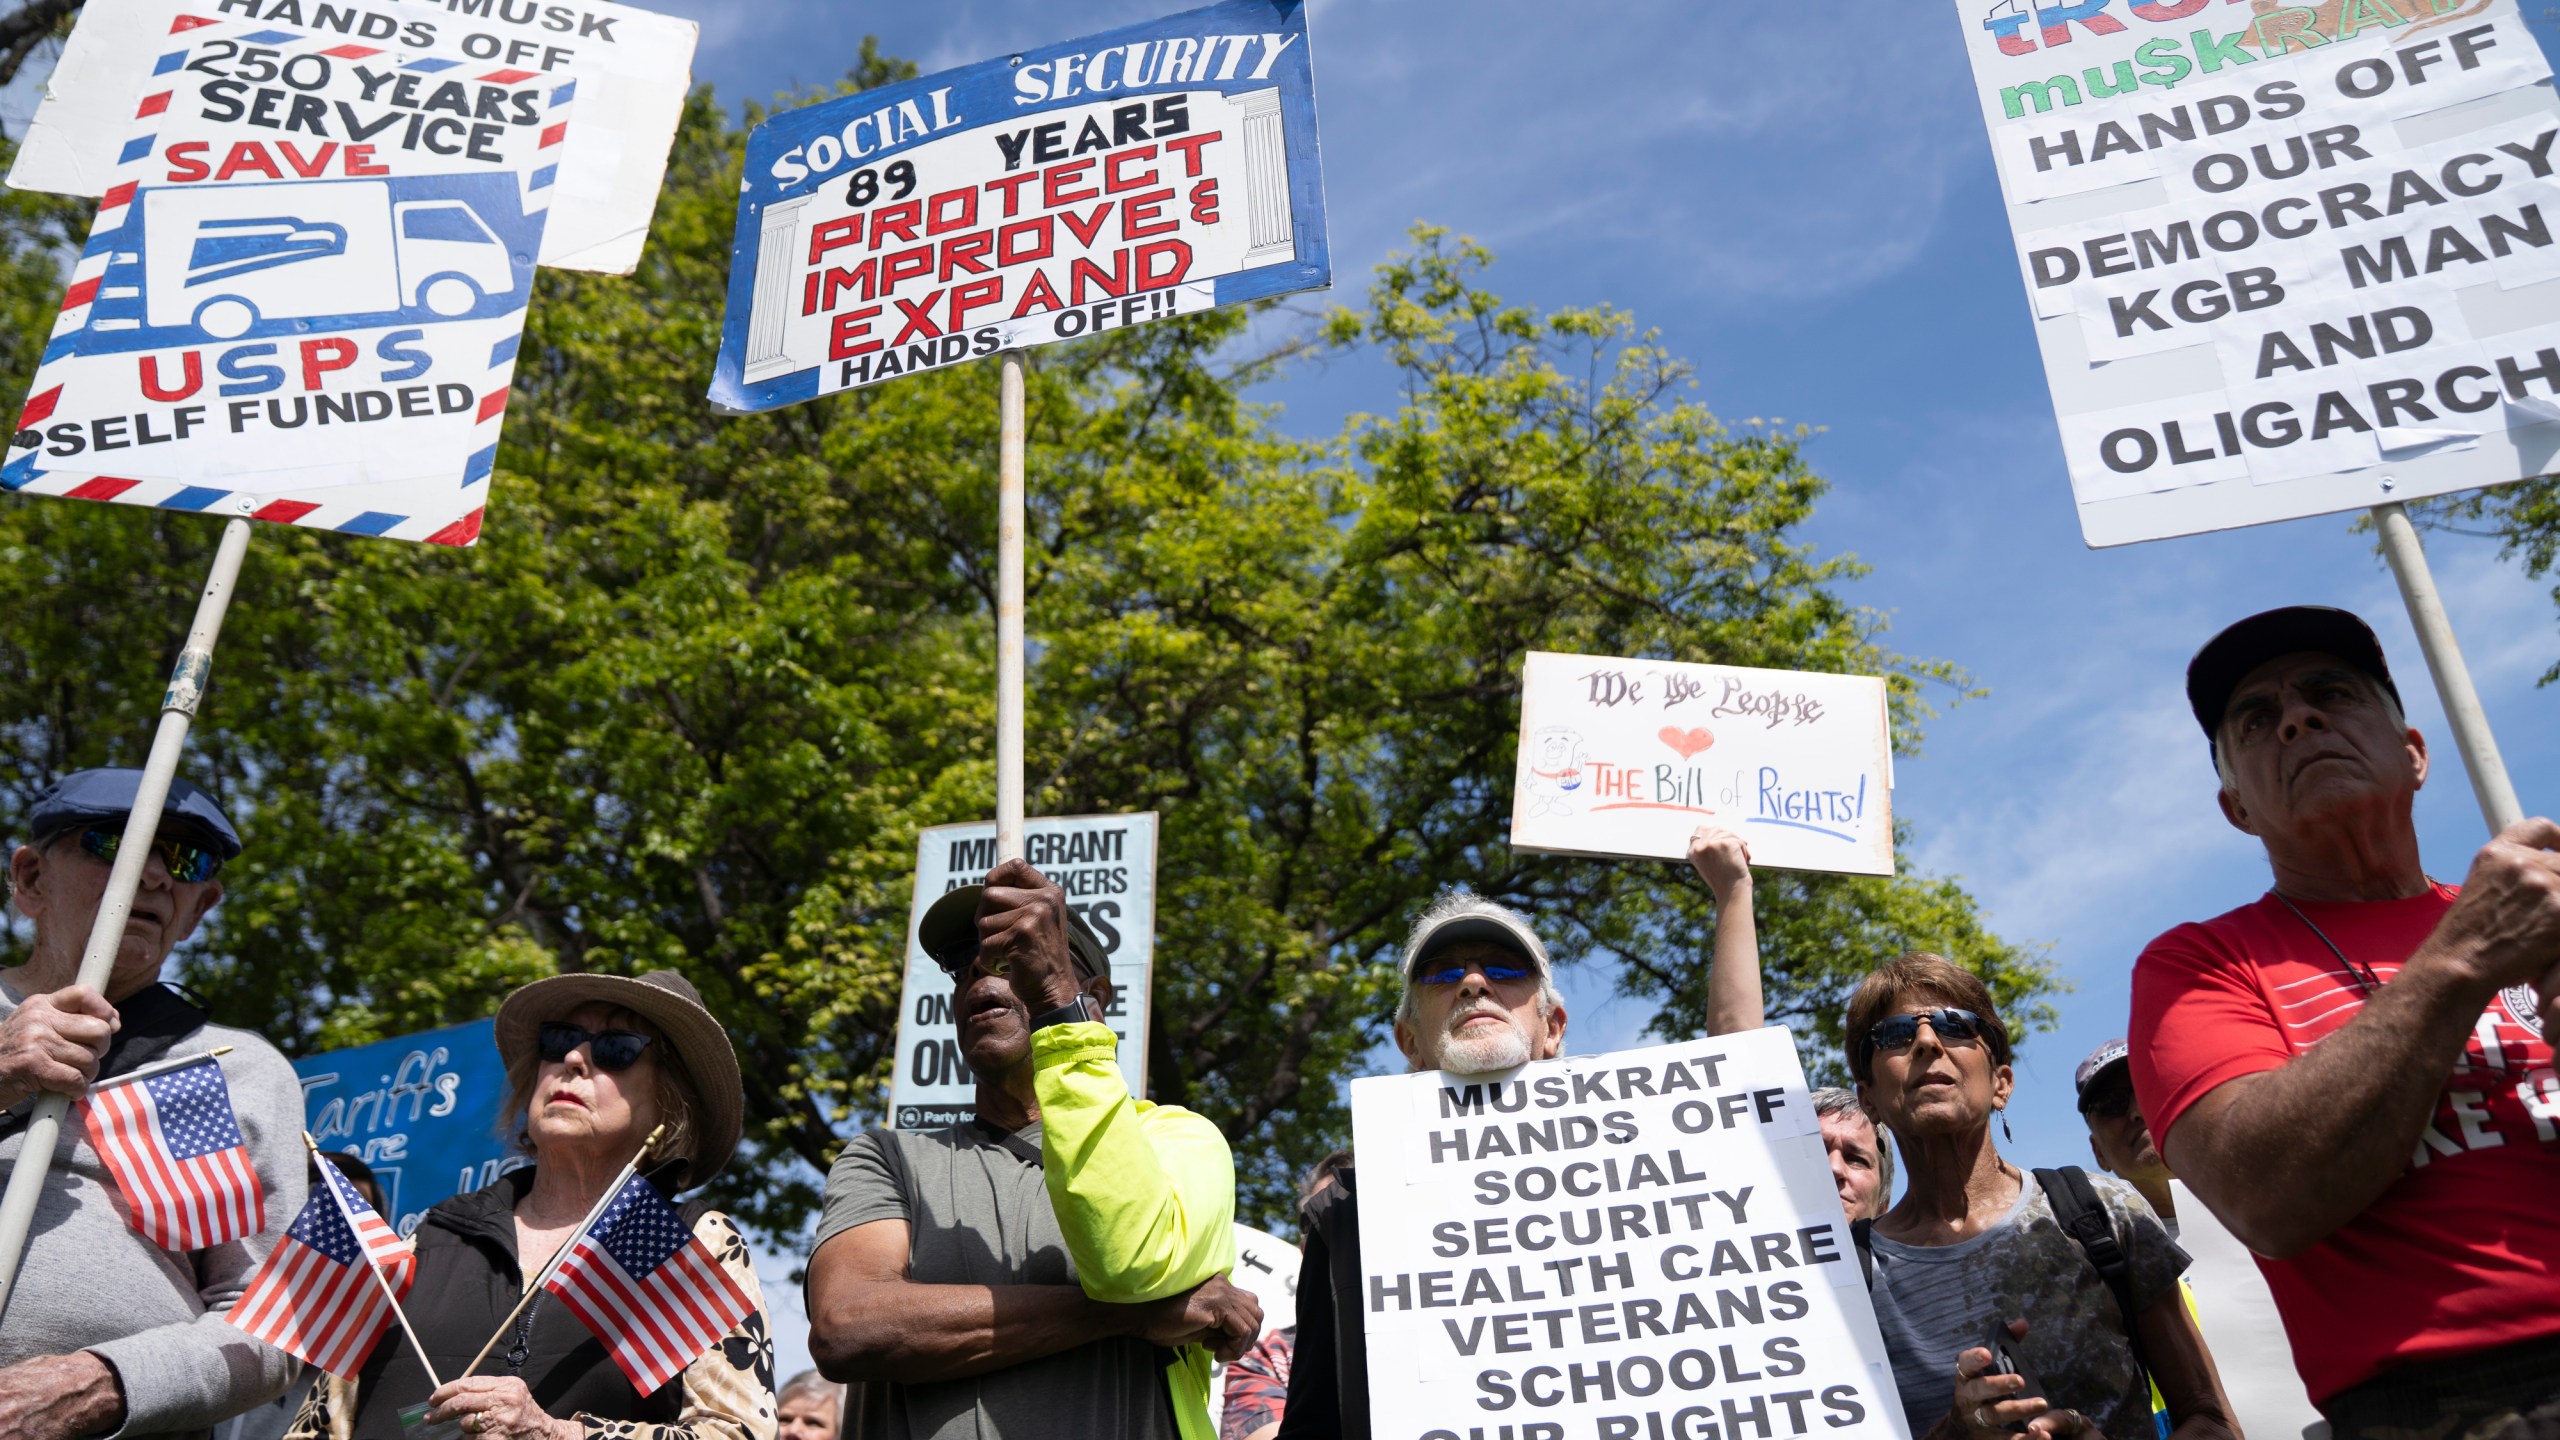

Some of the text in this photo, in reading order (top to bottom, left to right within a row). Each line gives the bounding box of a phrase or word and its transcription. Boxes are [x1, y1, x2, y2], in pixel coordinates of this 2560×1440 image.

[217, 0, 575, 72] HANDS OFF
[2000, 0, 2458, 119] mu$kRA
[185, 40, 541, 126] 250 YEARS
[770, 32, 1299, 191] SOCIAL SECURITY
[2028, 23, 2497, 173] HANDS OFF
[200, 79, 505, 163] SERVICE
[845, 93, 1190, 208] 89 YEARS
[165, 141, 390, 183] SAVE
[2192, 123, 2374, 195] OUR
[808, 130, 1223, 266] PROTECT
[2028, 128, 2559, 289] DEMOCRACY
[802, 187, 1180, 317] IMPROVE
[2107, 203, 2554, 338] KGB MAN
[829, 238, 1194, 362] EXPAND
[139, 328, 433, 402] USPS
[840, 289, 1177, 388] HANDS OFF!!
[2255, 305, 2434, 379] AND
[45, 382, 474, 457] SELF FUNDED
[2099, 347, 2560, 474] OLIGARCH
[1578, 670, 1644, 708] We
[1584, 763, 1645, 801] THE
[1655, 764, 1704, 808] Bill
[1720, 770, 1745, 807] of
[949, 828, 1127, 873] IMGRANT
[1045, 867, 1128, 897] RKERS
[915, 994, 955, 1026] ON
[911, 1039, 976, 1087] ON
[1437, 1053, 1728, 1119] MUSKRAT
[924, 1111, 957, 1125] Party
[1428, 1087, 1786, 1164] HANDS OFF
[1473, 1149, 1707, 1206] SOCIAL
[1431, 1186, 1755, 1258] SECURITY
[1369, 1223, 1842, 1313] HEALTH CARE
[1442, 1280, 1810, 1357] VETERANS
[1475, 1336, 1807, 1412] SCHOOLS
[1596, 1384, 1867, 1440] RIGHTS
